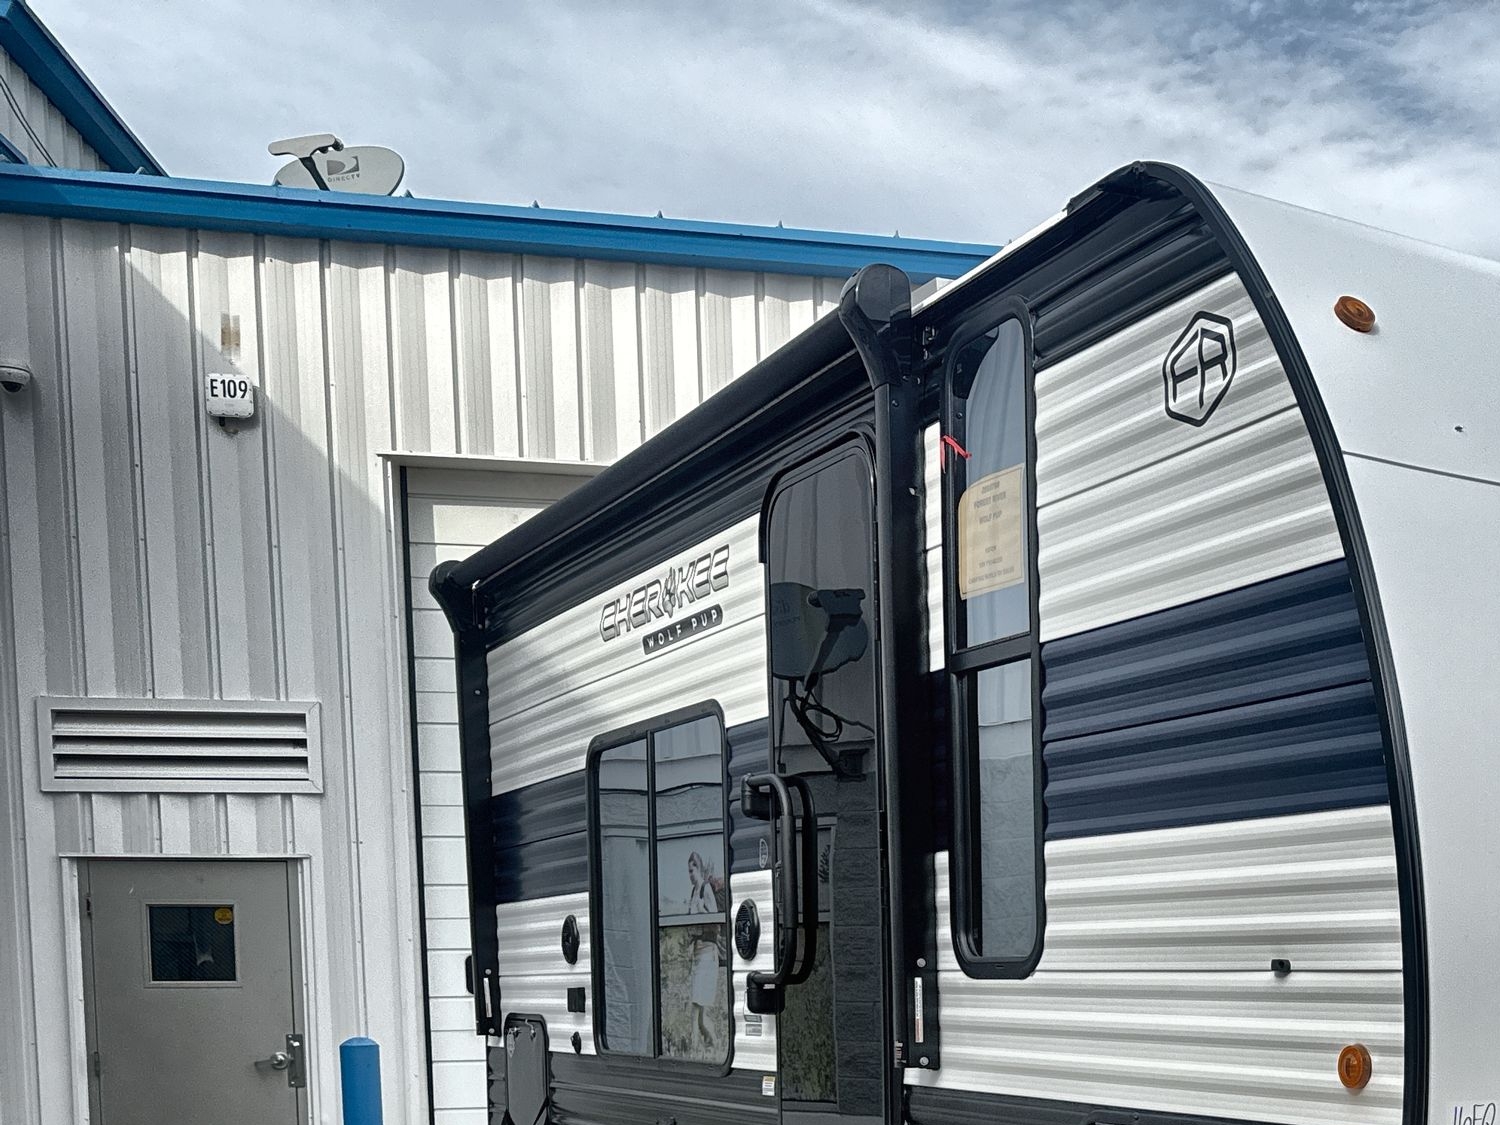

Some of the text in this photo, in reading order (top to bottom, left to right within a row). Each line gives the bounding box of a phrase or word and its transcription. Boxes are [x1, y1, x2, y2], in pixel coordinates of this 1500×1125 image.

[210, 378, 248, 399] E109
[646, 609, 718, 648] WOLF PUP
